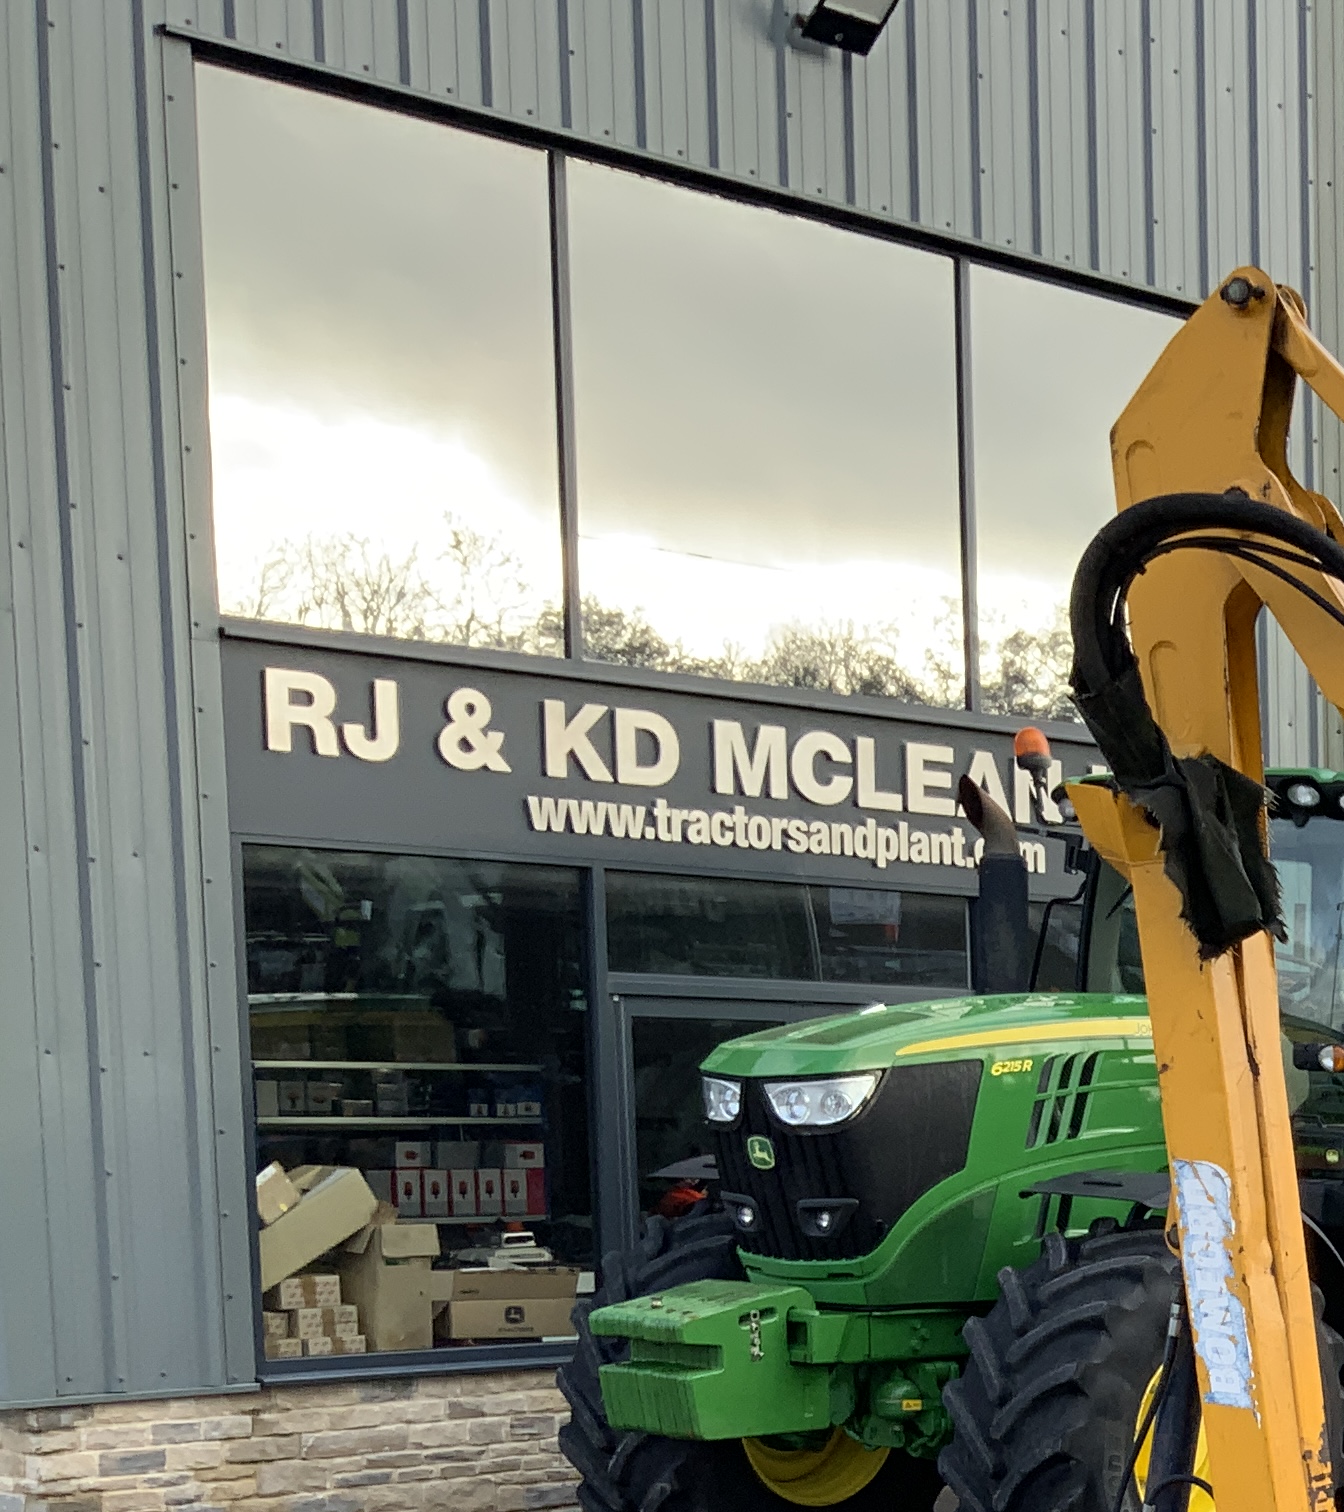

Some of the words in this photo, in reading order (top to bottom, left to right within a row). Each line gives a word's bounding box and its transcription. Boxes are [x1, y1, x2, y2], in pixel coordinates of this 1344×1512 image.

[264, 667, 400, 762] RJ
[438, 687, 512, 774] &
[543, 699, 680, 787] KD
[711, 720, 1064, 824] MCLEAN
[527, 795, 1047, 874] www.tractorsandplant.cm
[1181, 1178, 1243, 1393] BOMFORD
